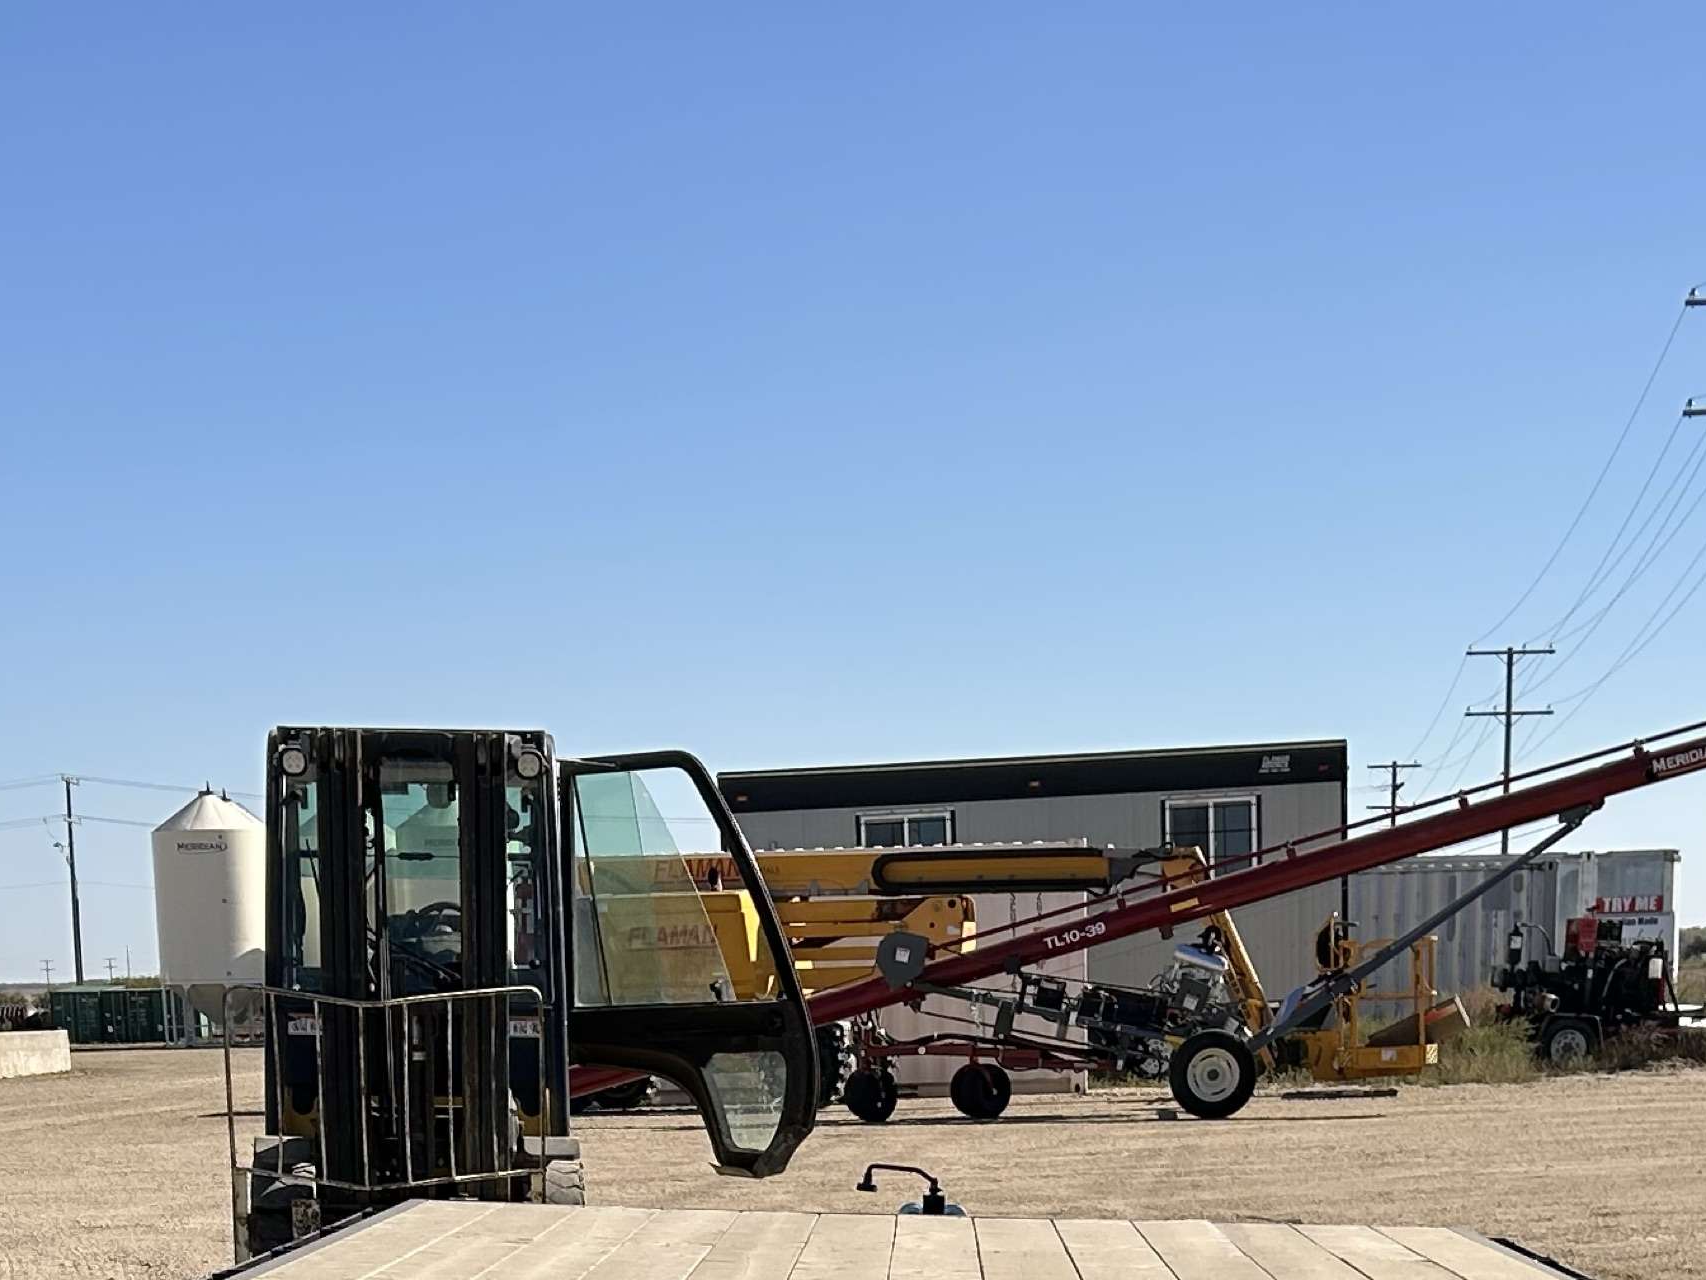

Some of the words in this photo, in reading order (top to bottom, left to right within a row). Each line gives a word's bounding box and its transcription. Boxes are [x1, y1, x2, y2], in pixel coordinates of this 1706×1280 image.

[1603, 896, 1632, 912] TRY
[1635, 896, 1657, 912] ME
[1043, 922, 1106, 949] TL10-39
